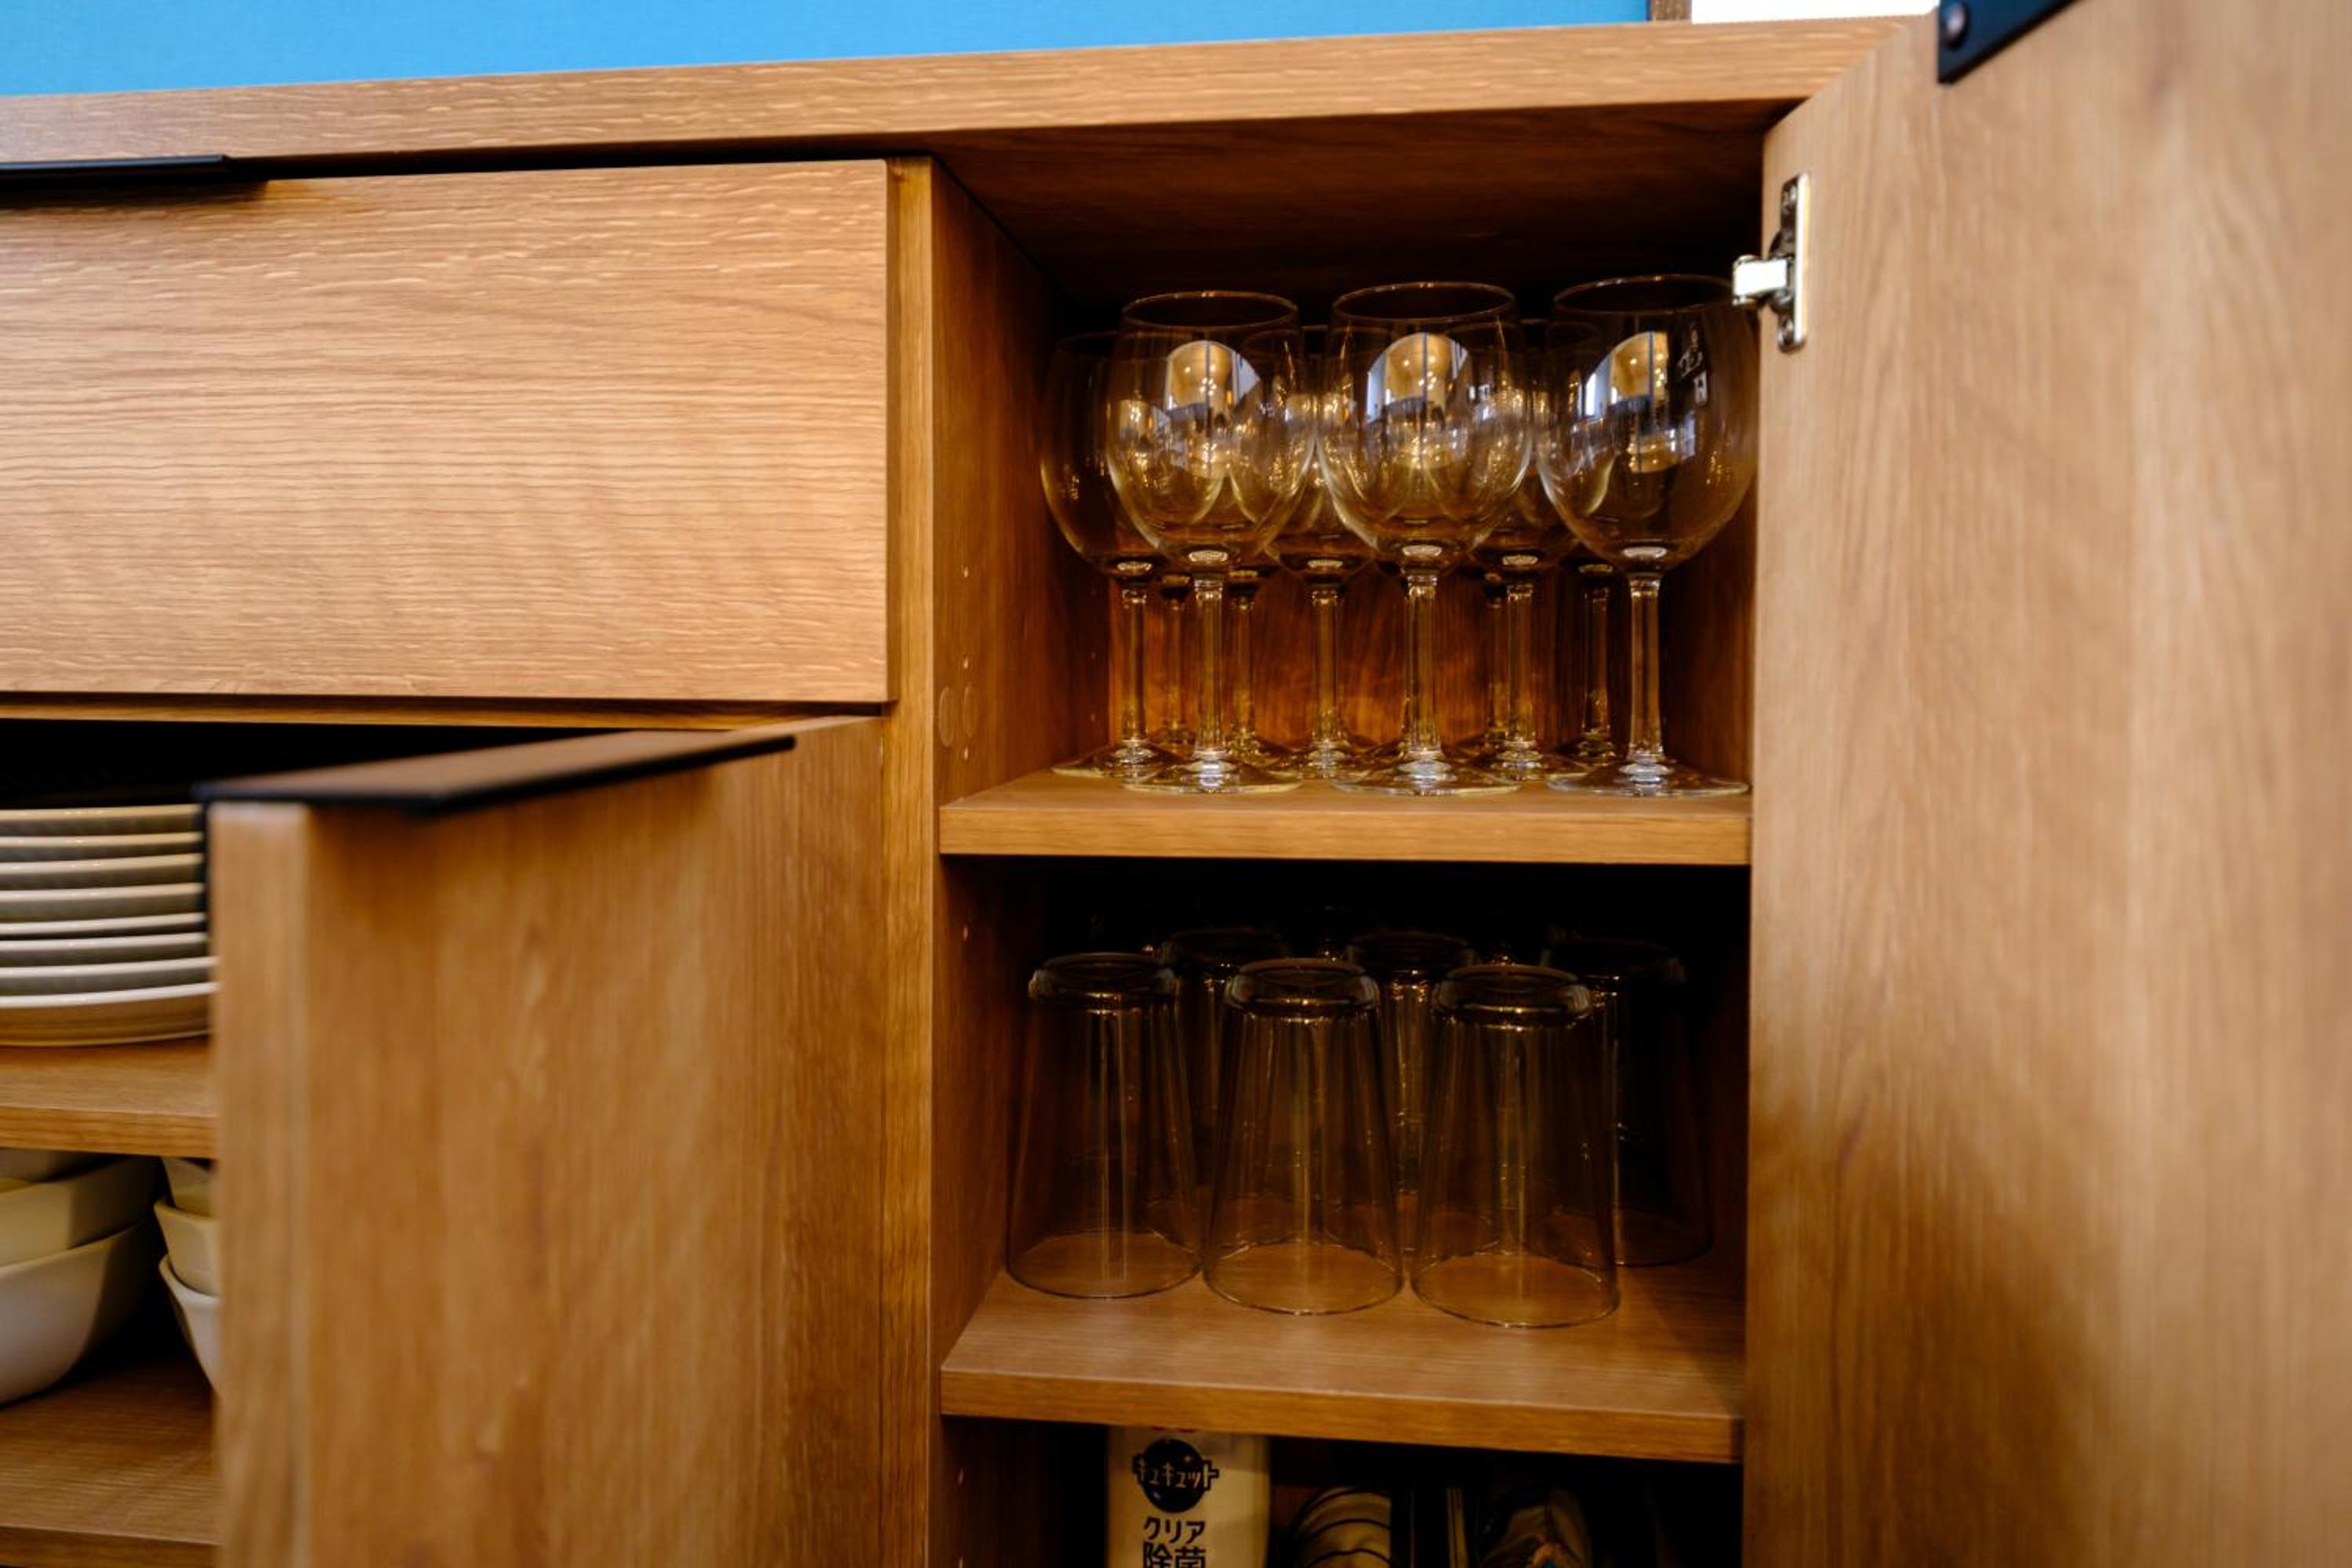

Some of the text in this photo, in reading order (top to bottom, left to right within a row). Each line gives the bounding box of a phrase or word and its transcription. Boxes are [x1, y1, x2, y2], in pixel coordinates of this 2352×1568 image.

[1134, 1454, 1219, 1490] キュキュット
[1143, 1517, 1206, 1544] クリア
[1142, 1541, 1207, 1568] 除菌
